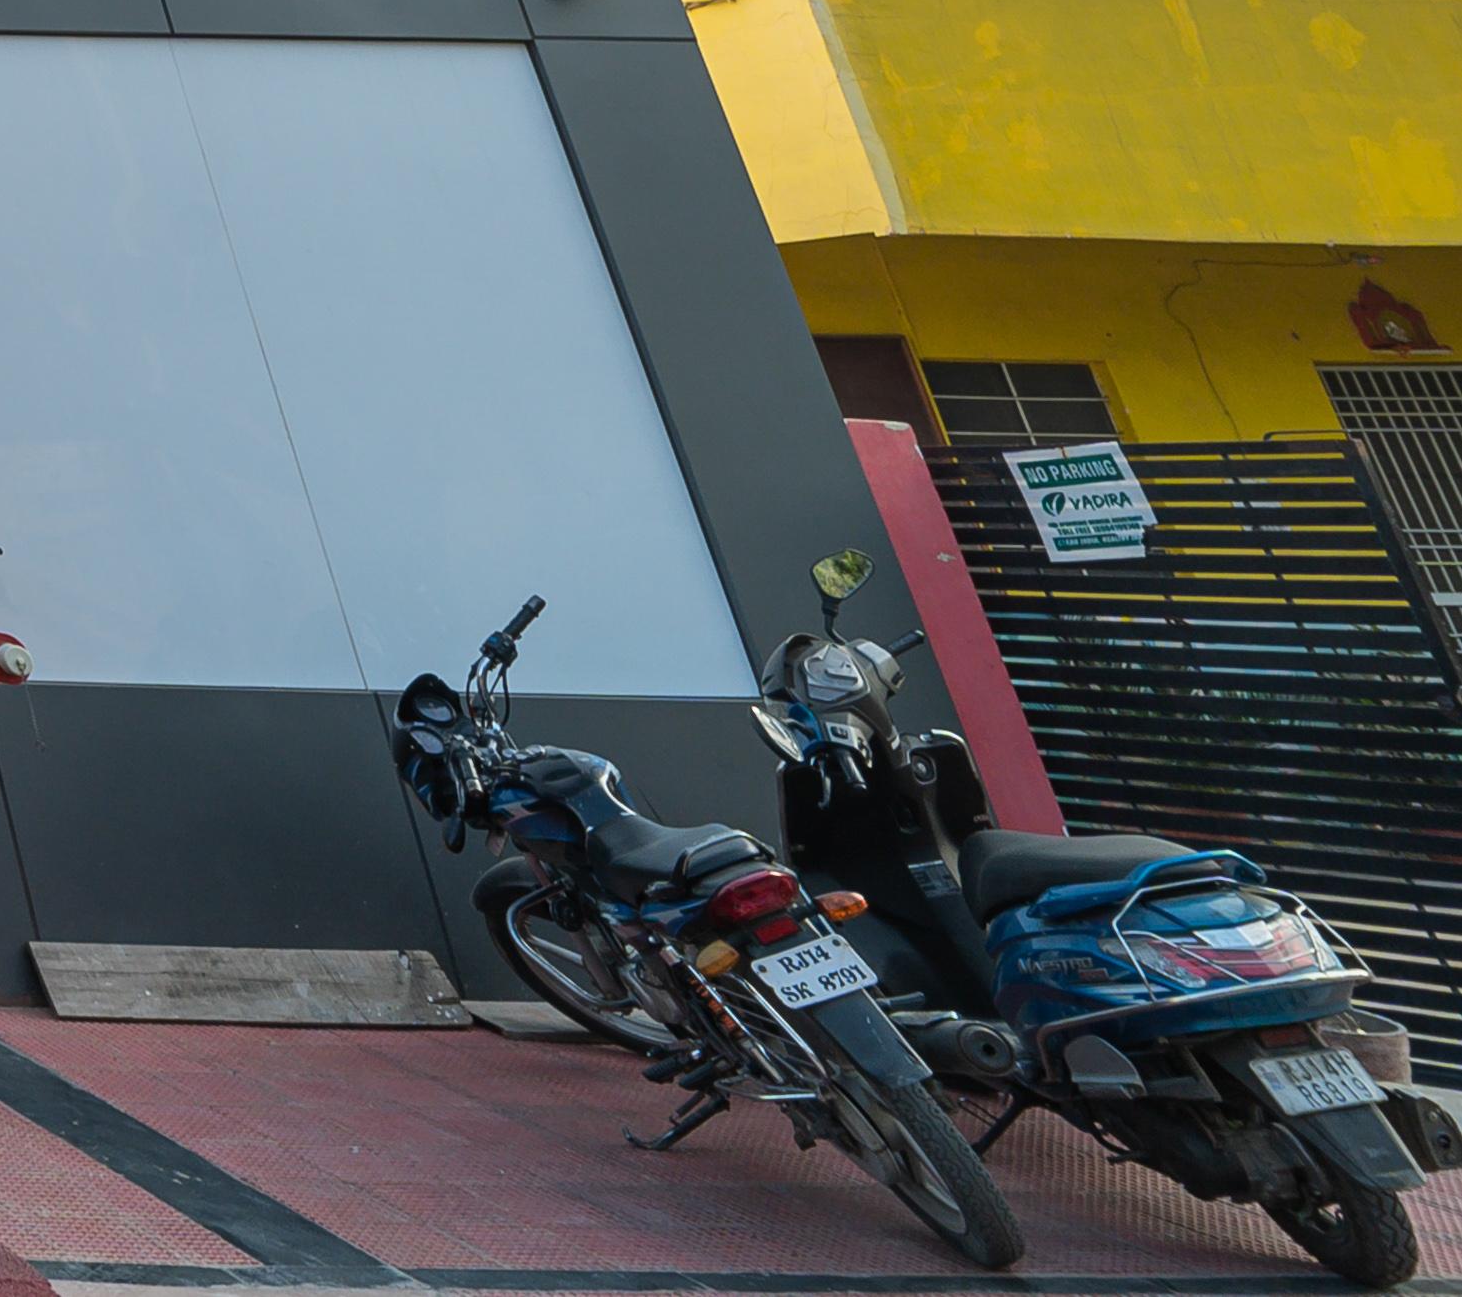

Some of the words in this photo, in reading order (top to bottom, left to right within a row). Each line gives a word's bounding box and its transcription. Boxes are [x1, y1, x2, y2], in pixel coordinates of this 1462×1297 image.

[1024, 466, 1048, 484] NO
[1048, 459, 1118, 481] PARKING
[777, 945, 832, 974] RJ14
[780, 981, 815, 1003] SK
[818, 964, 867, 992] 8791
